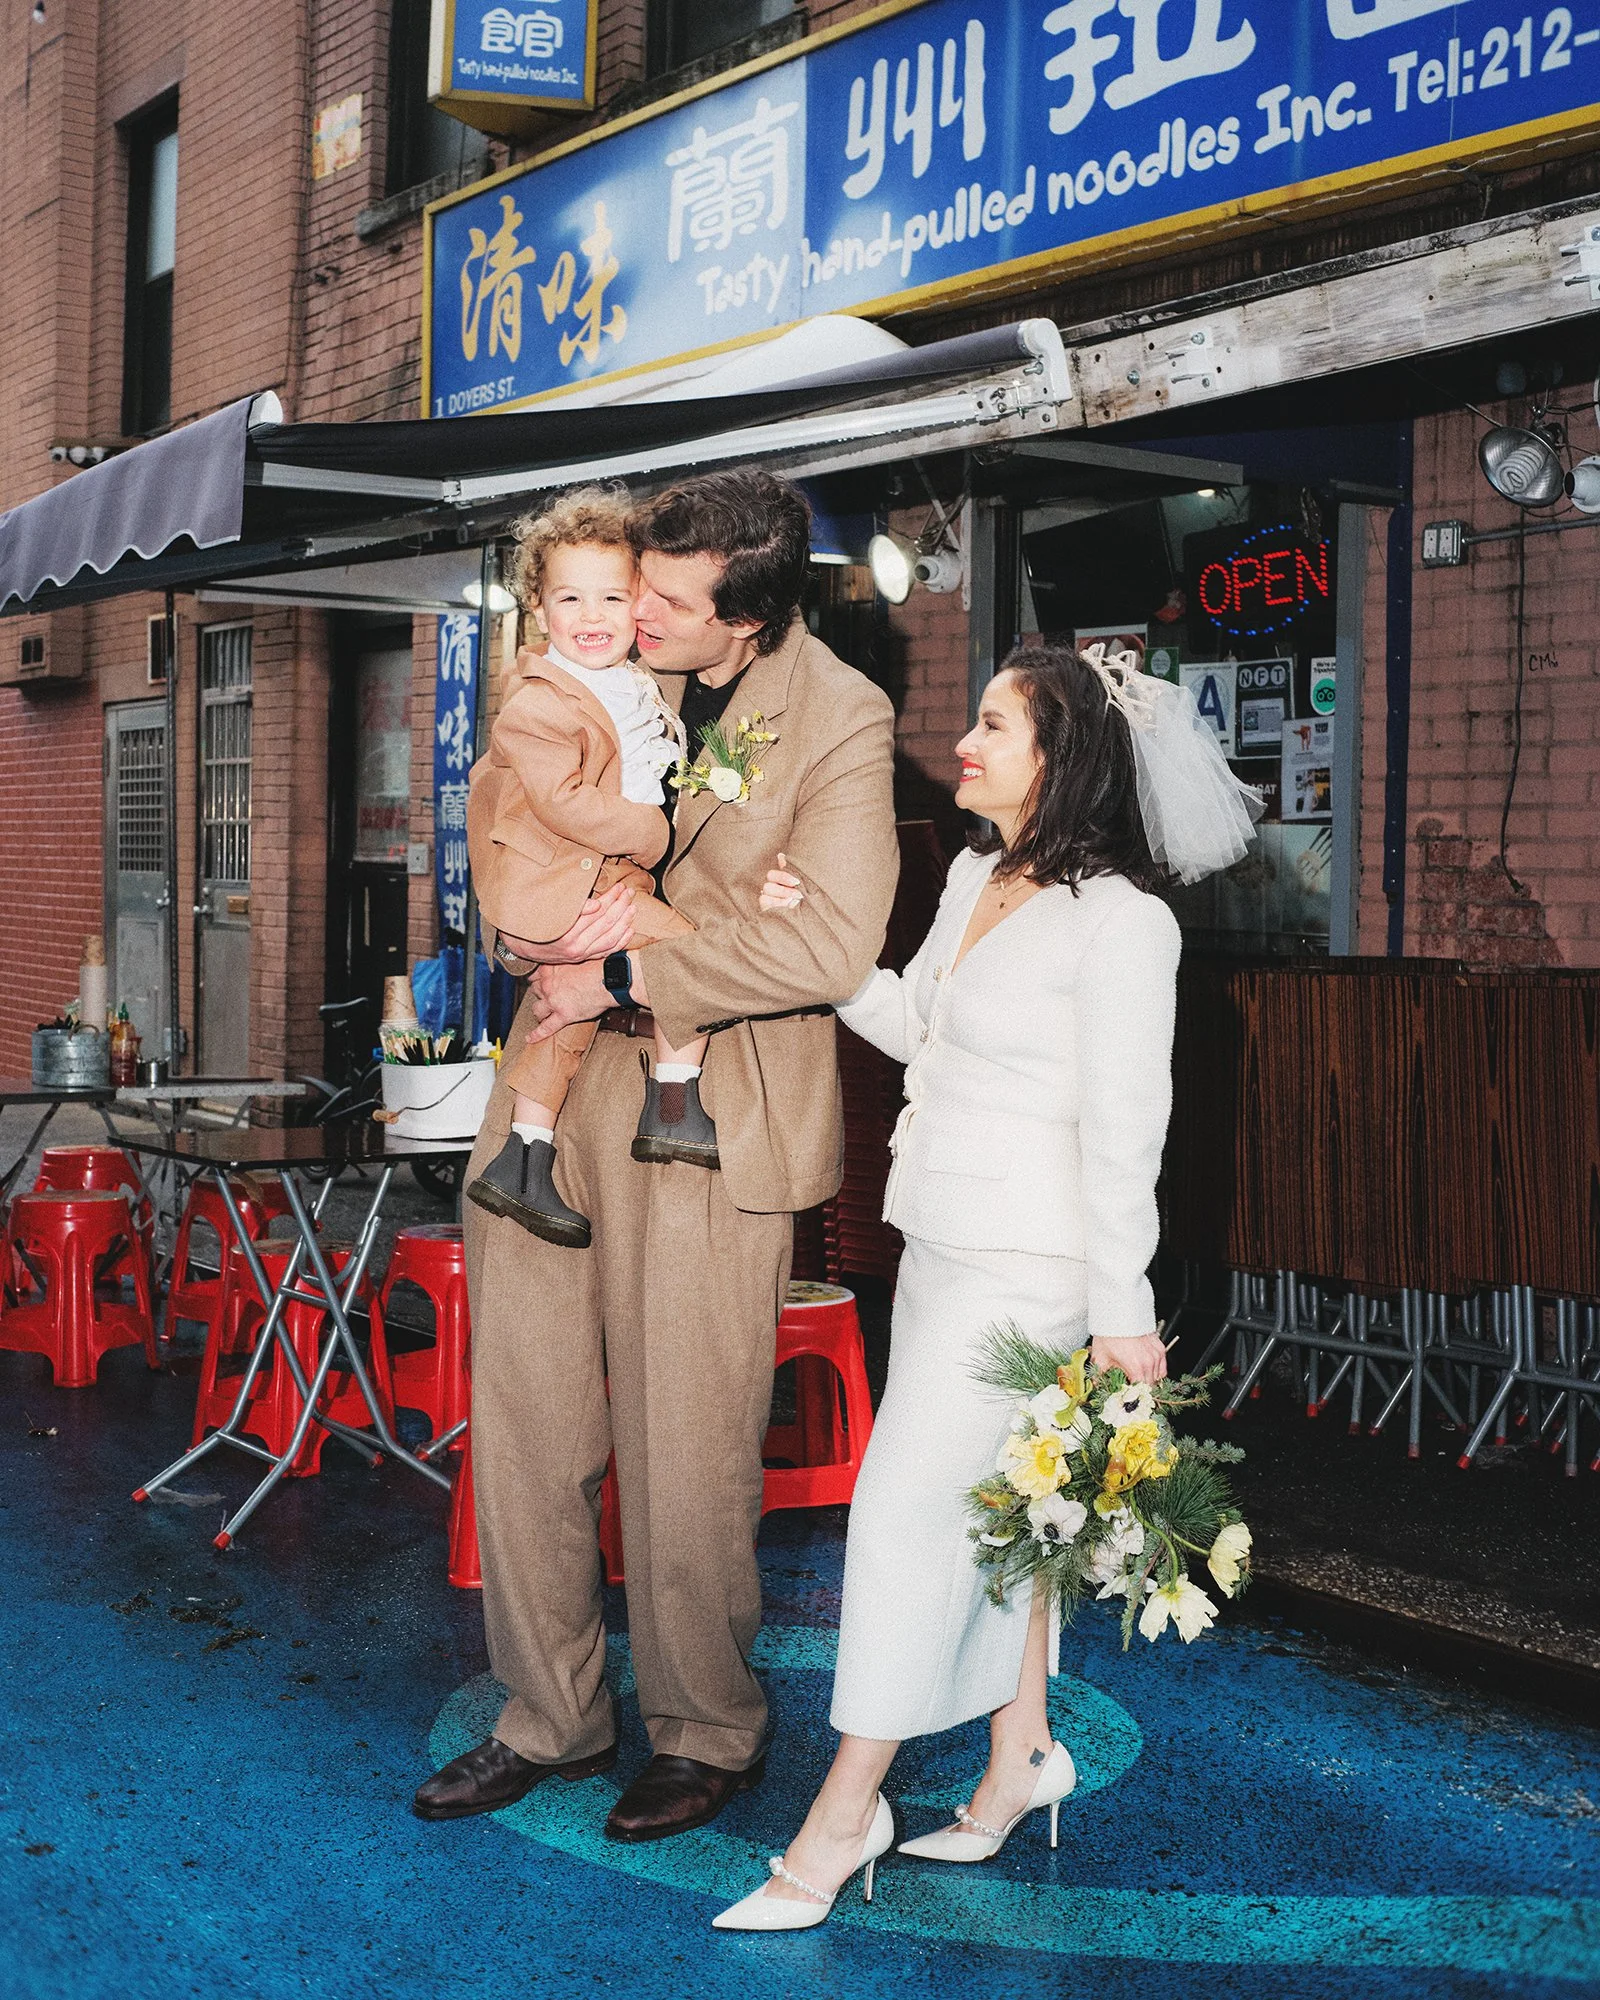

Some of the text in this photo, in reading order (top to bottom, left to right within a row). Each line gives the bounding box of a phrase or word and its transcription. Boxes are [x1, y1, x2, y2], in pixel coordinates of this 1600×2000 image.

[697, 252, 789, 315] Tasty
[802, 165, 1036, 288] hand-pulled
[1047, 117, 1240, 215] noodles
[1254, 81, 1372, 154] Inc.
[434, 376, 517, 418] 1 DOYERS ST.
[1200, 543, 1328, 614] OPEN
[1197, 675, 1226, 731] A
